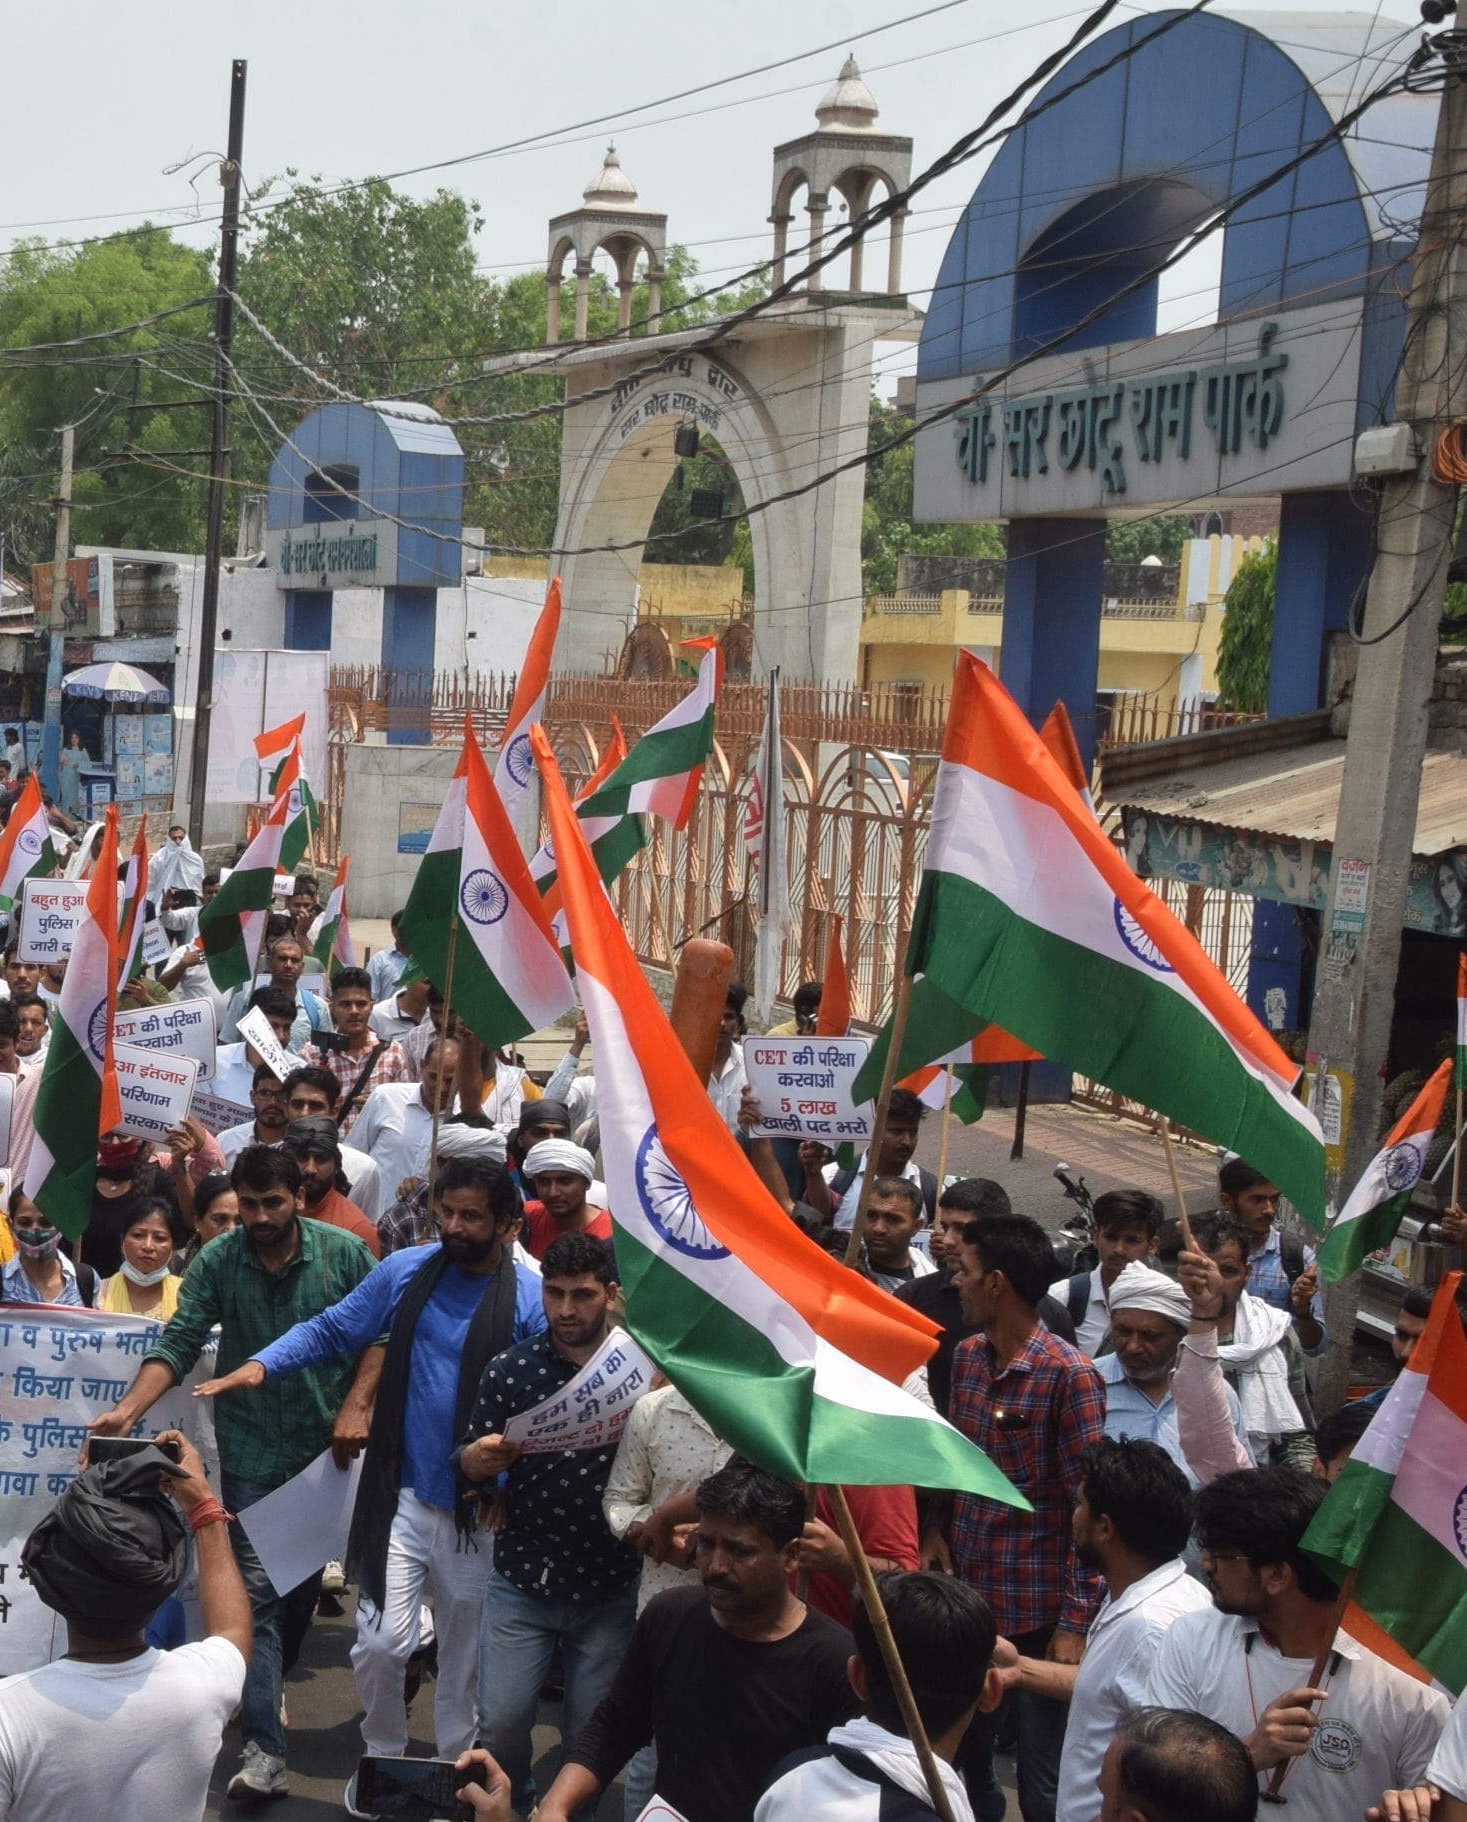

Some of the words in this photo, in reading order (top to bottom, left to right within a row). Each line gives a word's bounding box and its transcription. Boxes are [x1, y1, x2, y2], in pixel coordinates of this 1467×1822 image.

[1003, 396, 1054, 479] सर
[1129, 371, 1197, 462] राम
[1199, 321, 1288, 454] पार्क
[113, 692, 138, 702] KENT
[31, 895, 58, 910] बहुत
[62, 896, 84, 911] हुआ
[39, 915, 72, 934] पुलिस
[30, 938, 58, 952] जारी
[141, 1015, 160, 1033] की
[164, 1011, 202, 1029] परिक्षा
[754, 1050, 787, 1065] CET
[792, 1046, 814, 1066] की
[818, 1047, 856, 1067] परिक्षा
[139, 1064, 188, 1085] इंतजार
[777, 1069, 834, 1088] करवाओ
[121, 1086, 172, 1108] परिणाम
[780, 1098, 791, 1113] 5
[797, 1100, 837, 1115] लाख
[124, 1114, 175, 1134] सरकार
[761, 1114, 802, 1132] खाली
[806, 1122, 831, 1133] पद
[836, 1117, 868, 1134] भरो
[50, 1327, 106, 1361] पुरुष
[12, 1366, 74, 1400] किया
[531, 1400, 568, 1426] हम
[572, 1370, 605, 1404] सब
[603, 1347, 627, 1376] का
[527, 1418, 570, 1437] एक
[577, 1399, 600, 1423] ही
[605, 1368, 644, 1406] नारा
[22, 1418, 90, 1458] पुलिस
